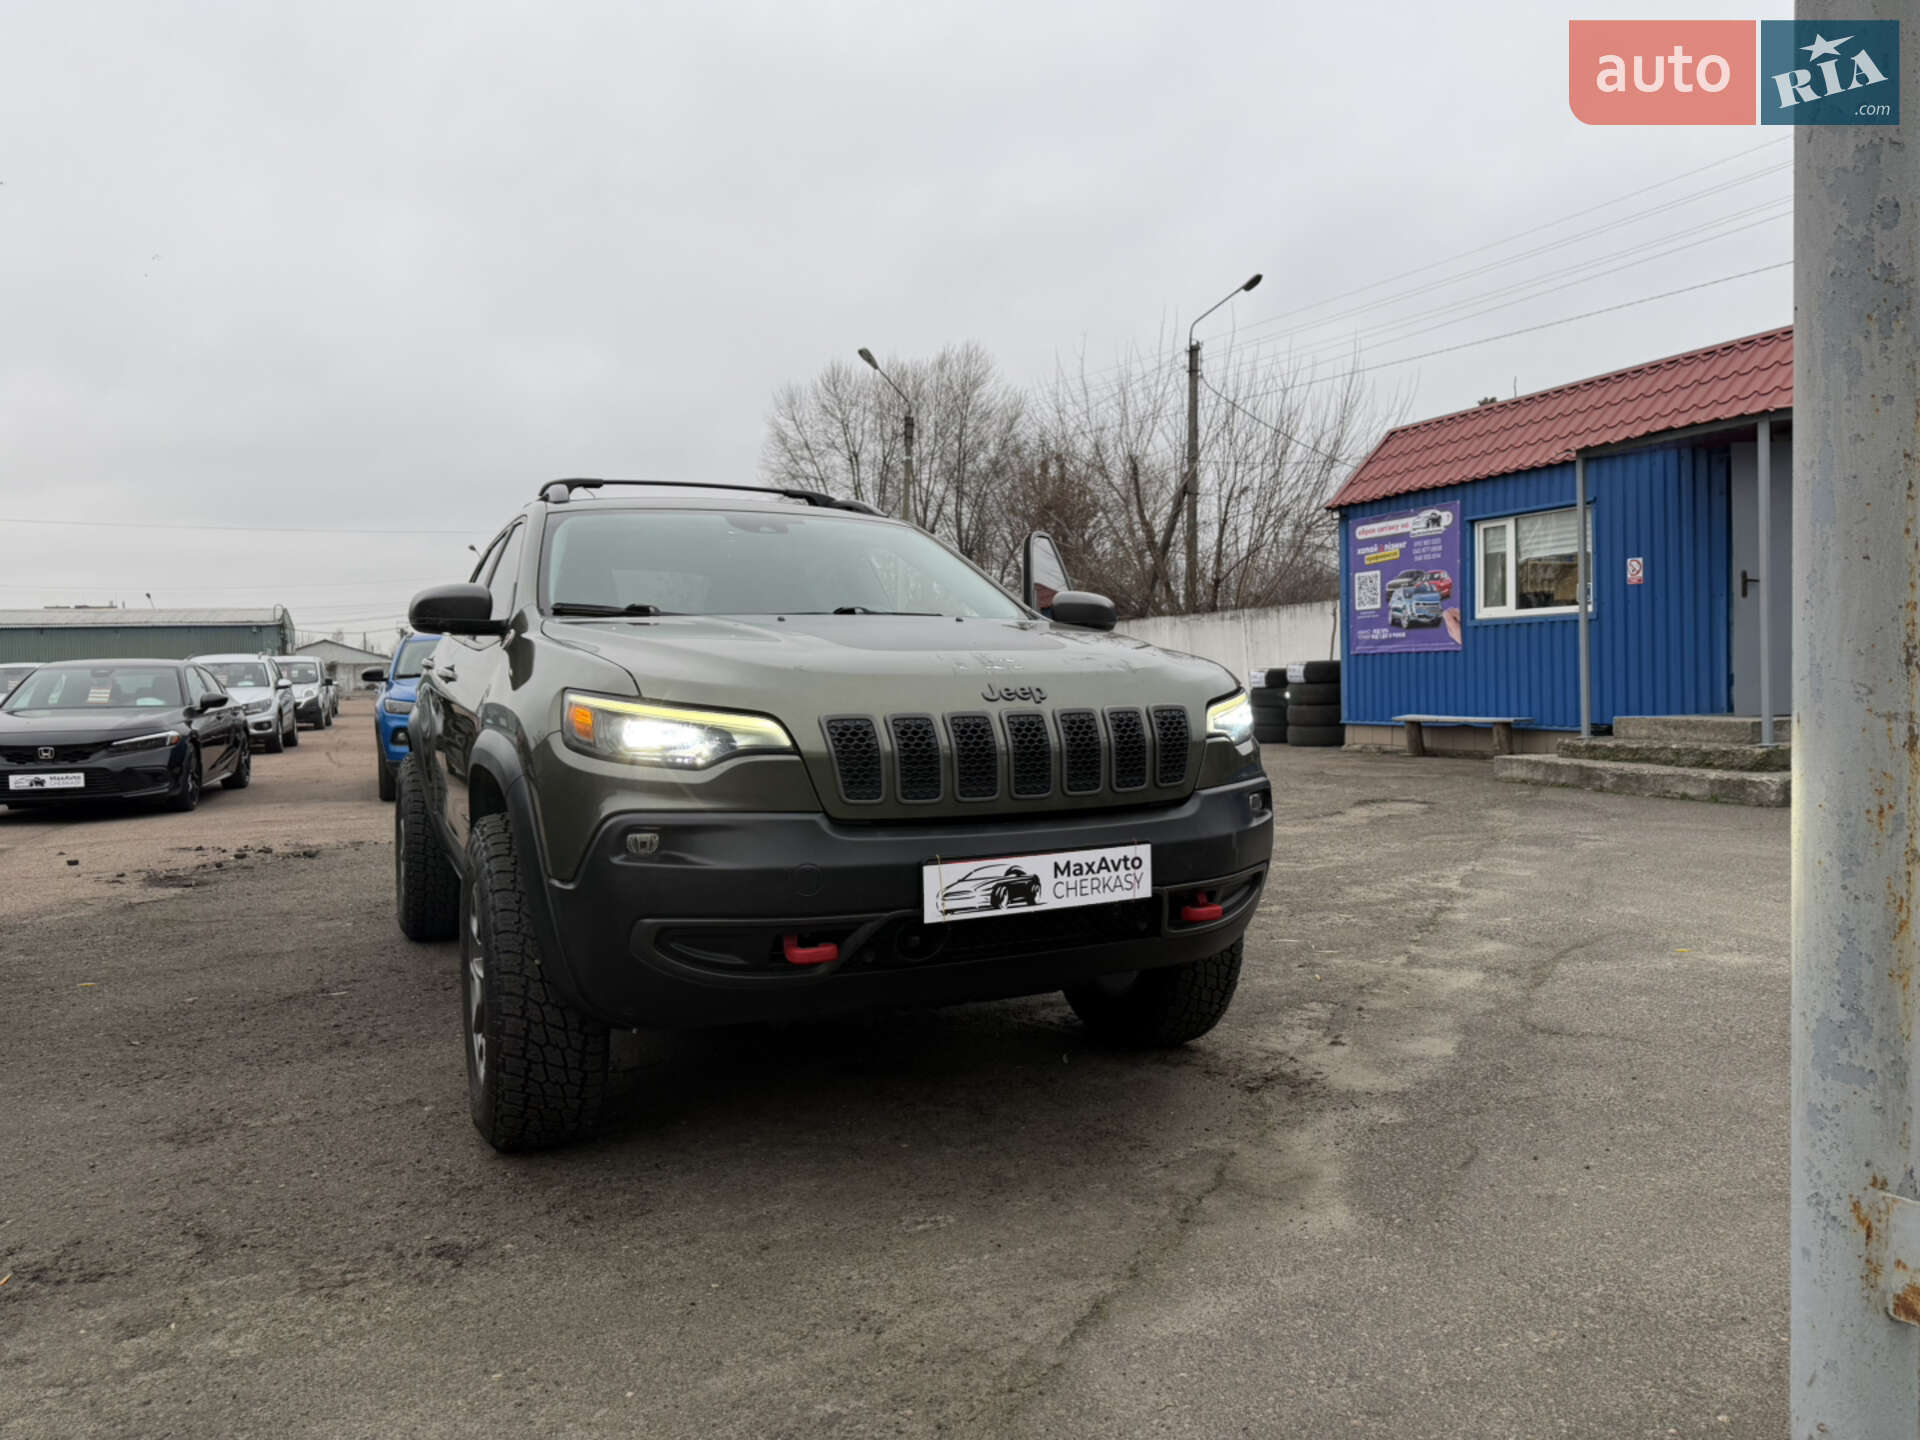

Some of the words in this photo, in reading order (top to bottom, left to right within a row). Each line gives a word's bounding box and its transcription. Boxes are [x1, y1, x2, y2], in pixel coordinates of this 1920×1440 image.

[980, 683, 1048, 705] Jeep
[1053, 855, 1143, 879] MaxAvto
[1052, 871, 1144, 899] CHERKASY
